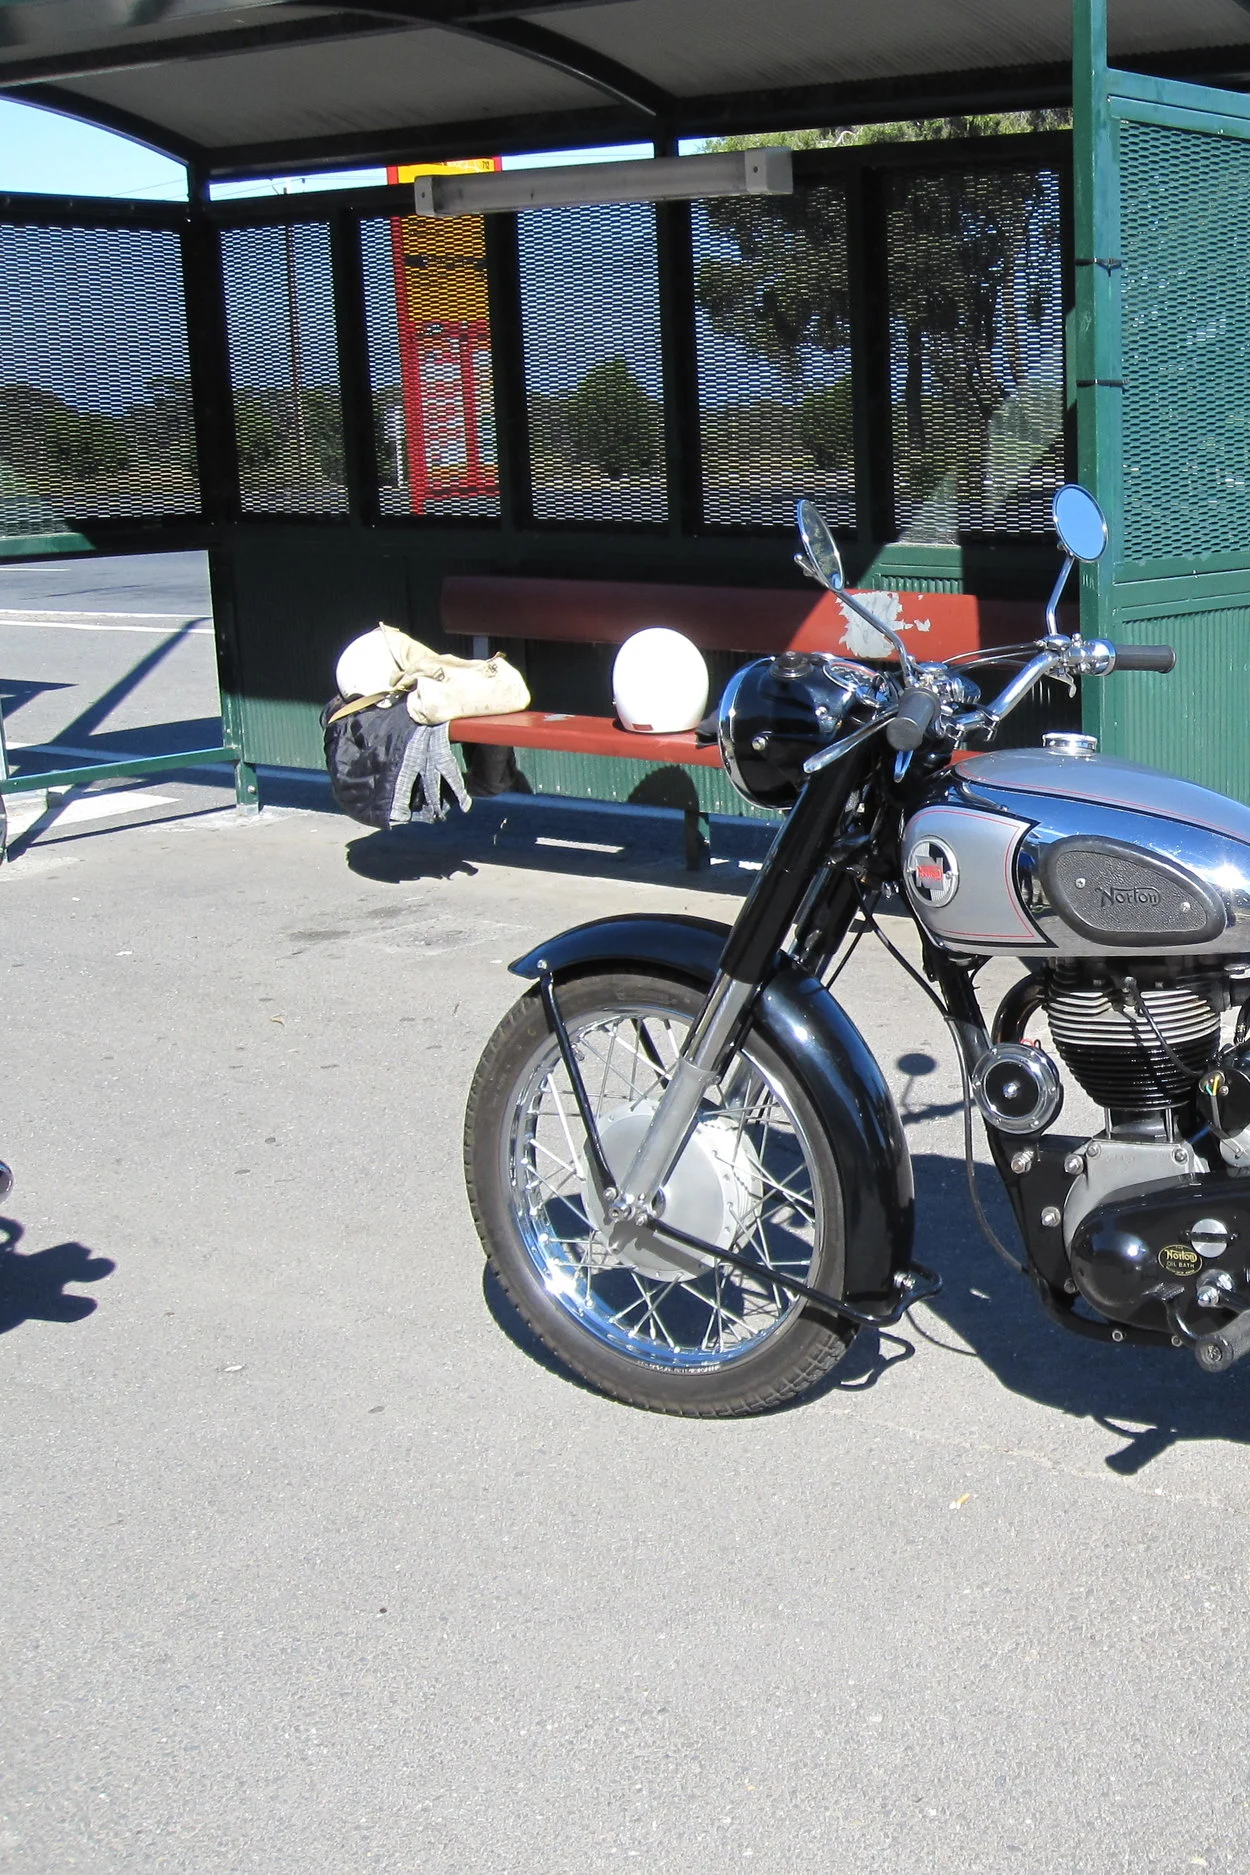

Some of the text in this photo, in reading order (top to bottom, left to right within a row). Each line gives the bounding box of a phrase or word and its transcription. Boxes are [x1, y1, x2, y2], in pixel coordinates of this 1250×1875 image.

[1094, 886, 1161, 908] Norton
[1164, 1249, 1198, 1263] Norton
[1178, 1261, 1195, 1269] BATH
